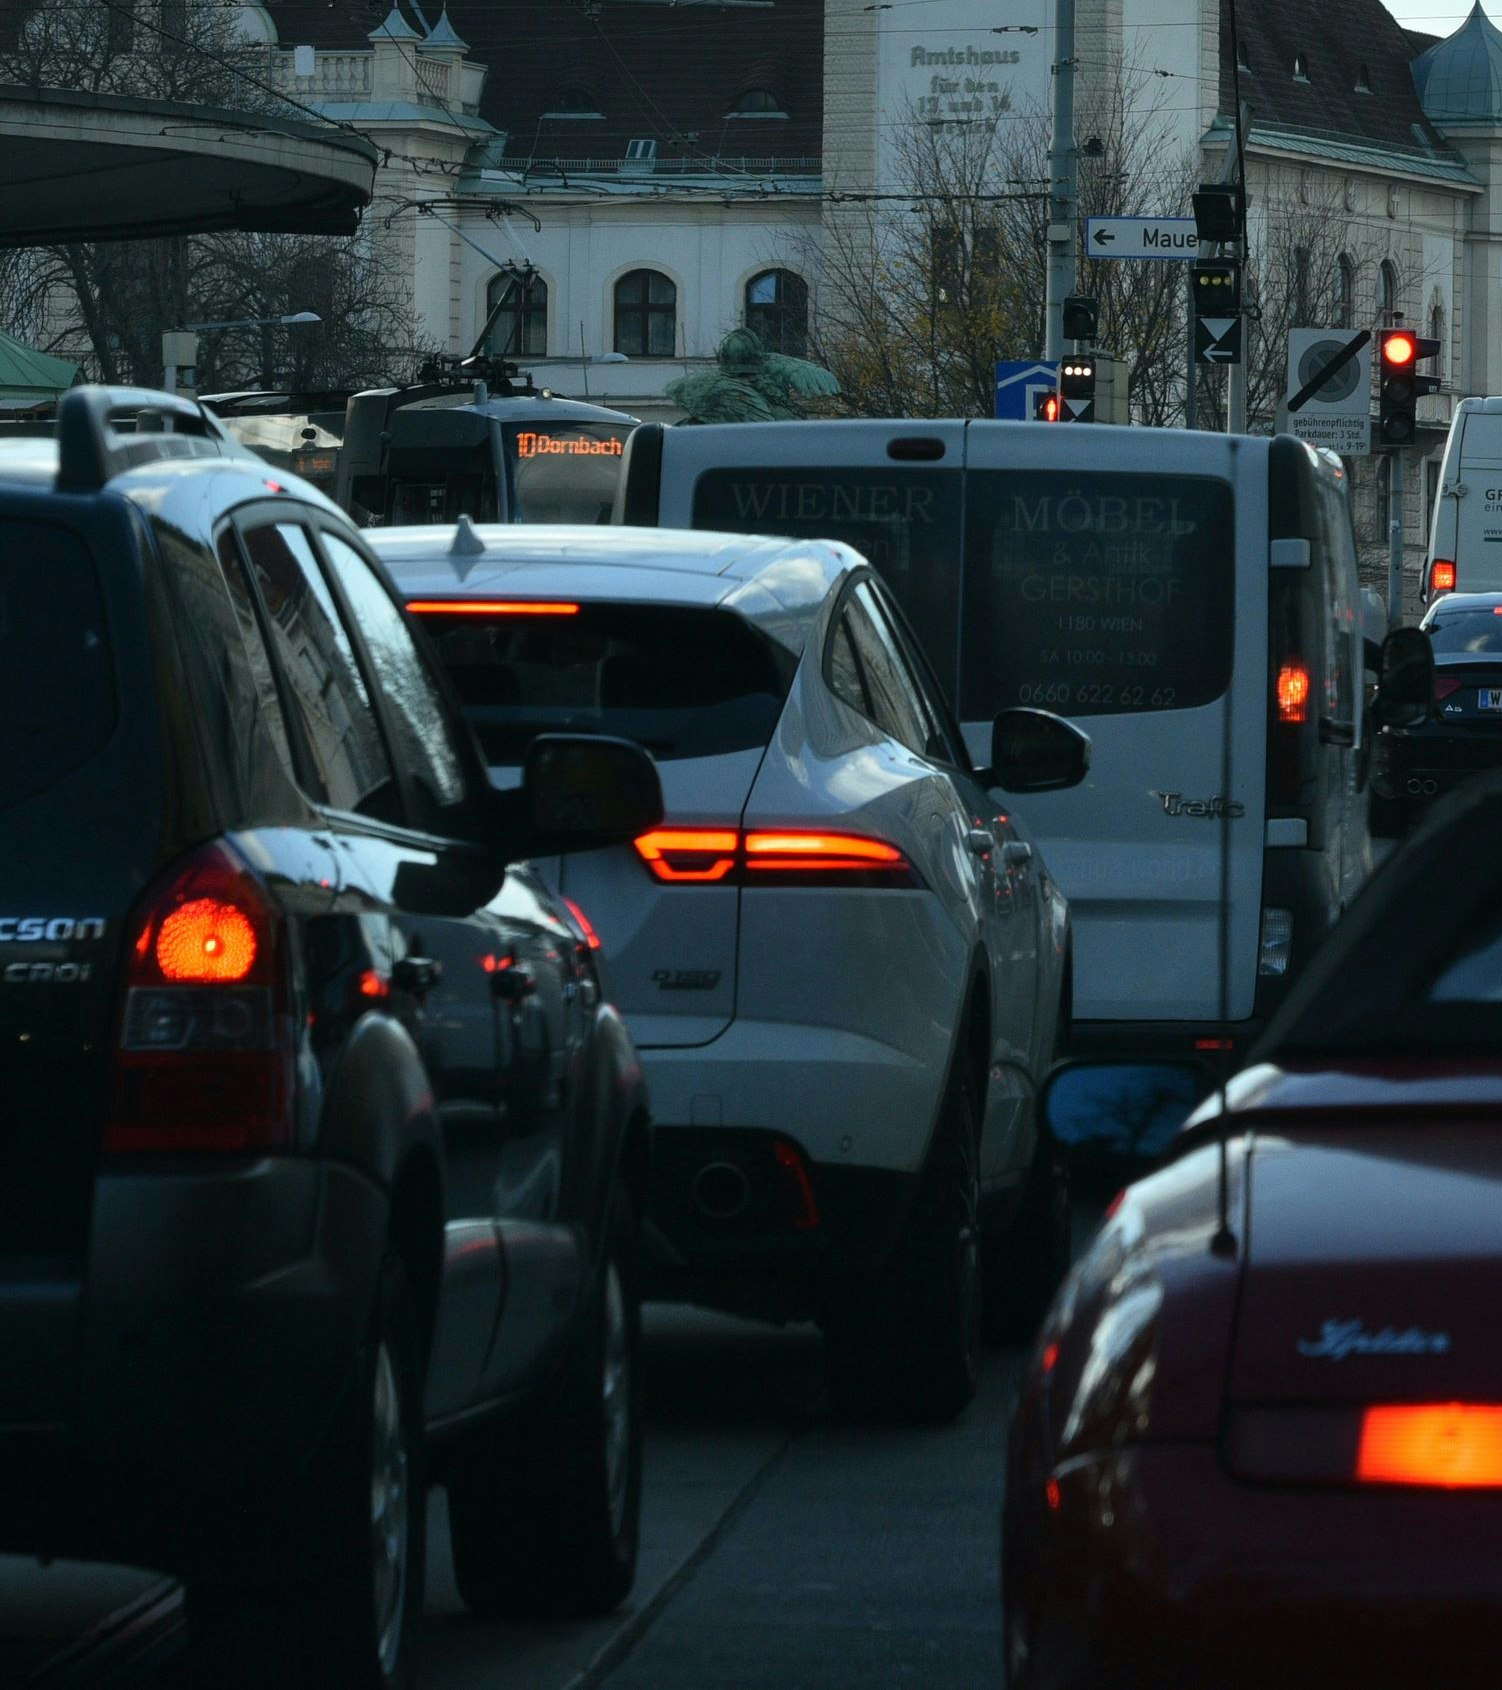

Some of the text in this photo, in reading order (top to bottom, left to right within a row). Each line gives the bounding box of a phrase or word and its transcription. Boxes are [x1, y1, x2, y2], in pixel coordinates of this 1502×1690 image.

[911, 45, 1020, 67] Amtshaus
[931, 76, 999, 93] für den
[1143, 228, 1199, 248] Maue
[1293, 417, 1364, 429] gebührenpflichtig
[1295, 429, 1338, 439] Parkdauer:
[1347, 431, 1362, 439] Std.
[516, 432, 623, 458] 10 Dornbach
[731, 483, 935, 522] WIENER
[1009, 489, 1198, 536] MÖBEL
[1021, 575, 1181, 604] GERSTHOF
[1100, 616, 1143, 631] WIEN
[1019, 683, 1176, 706] 0660 622 62 62
[1490, 692, 1500, 705] W
